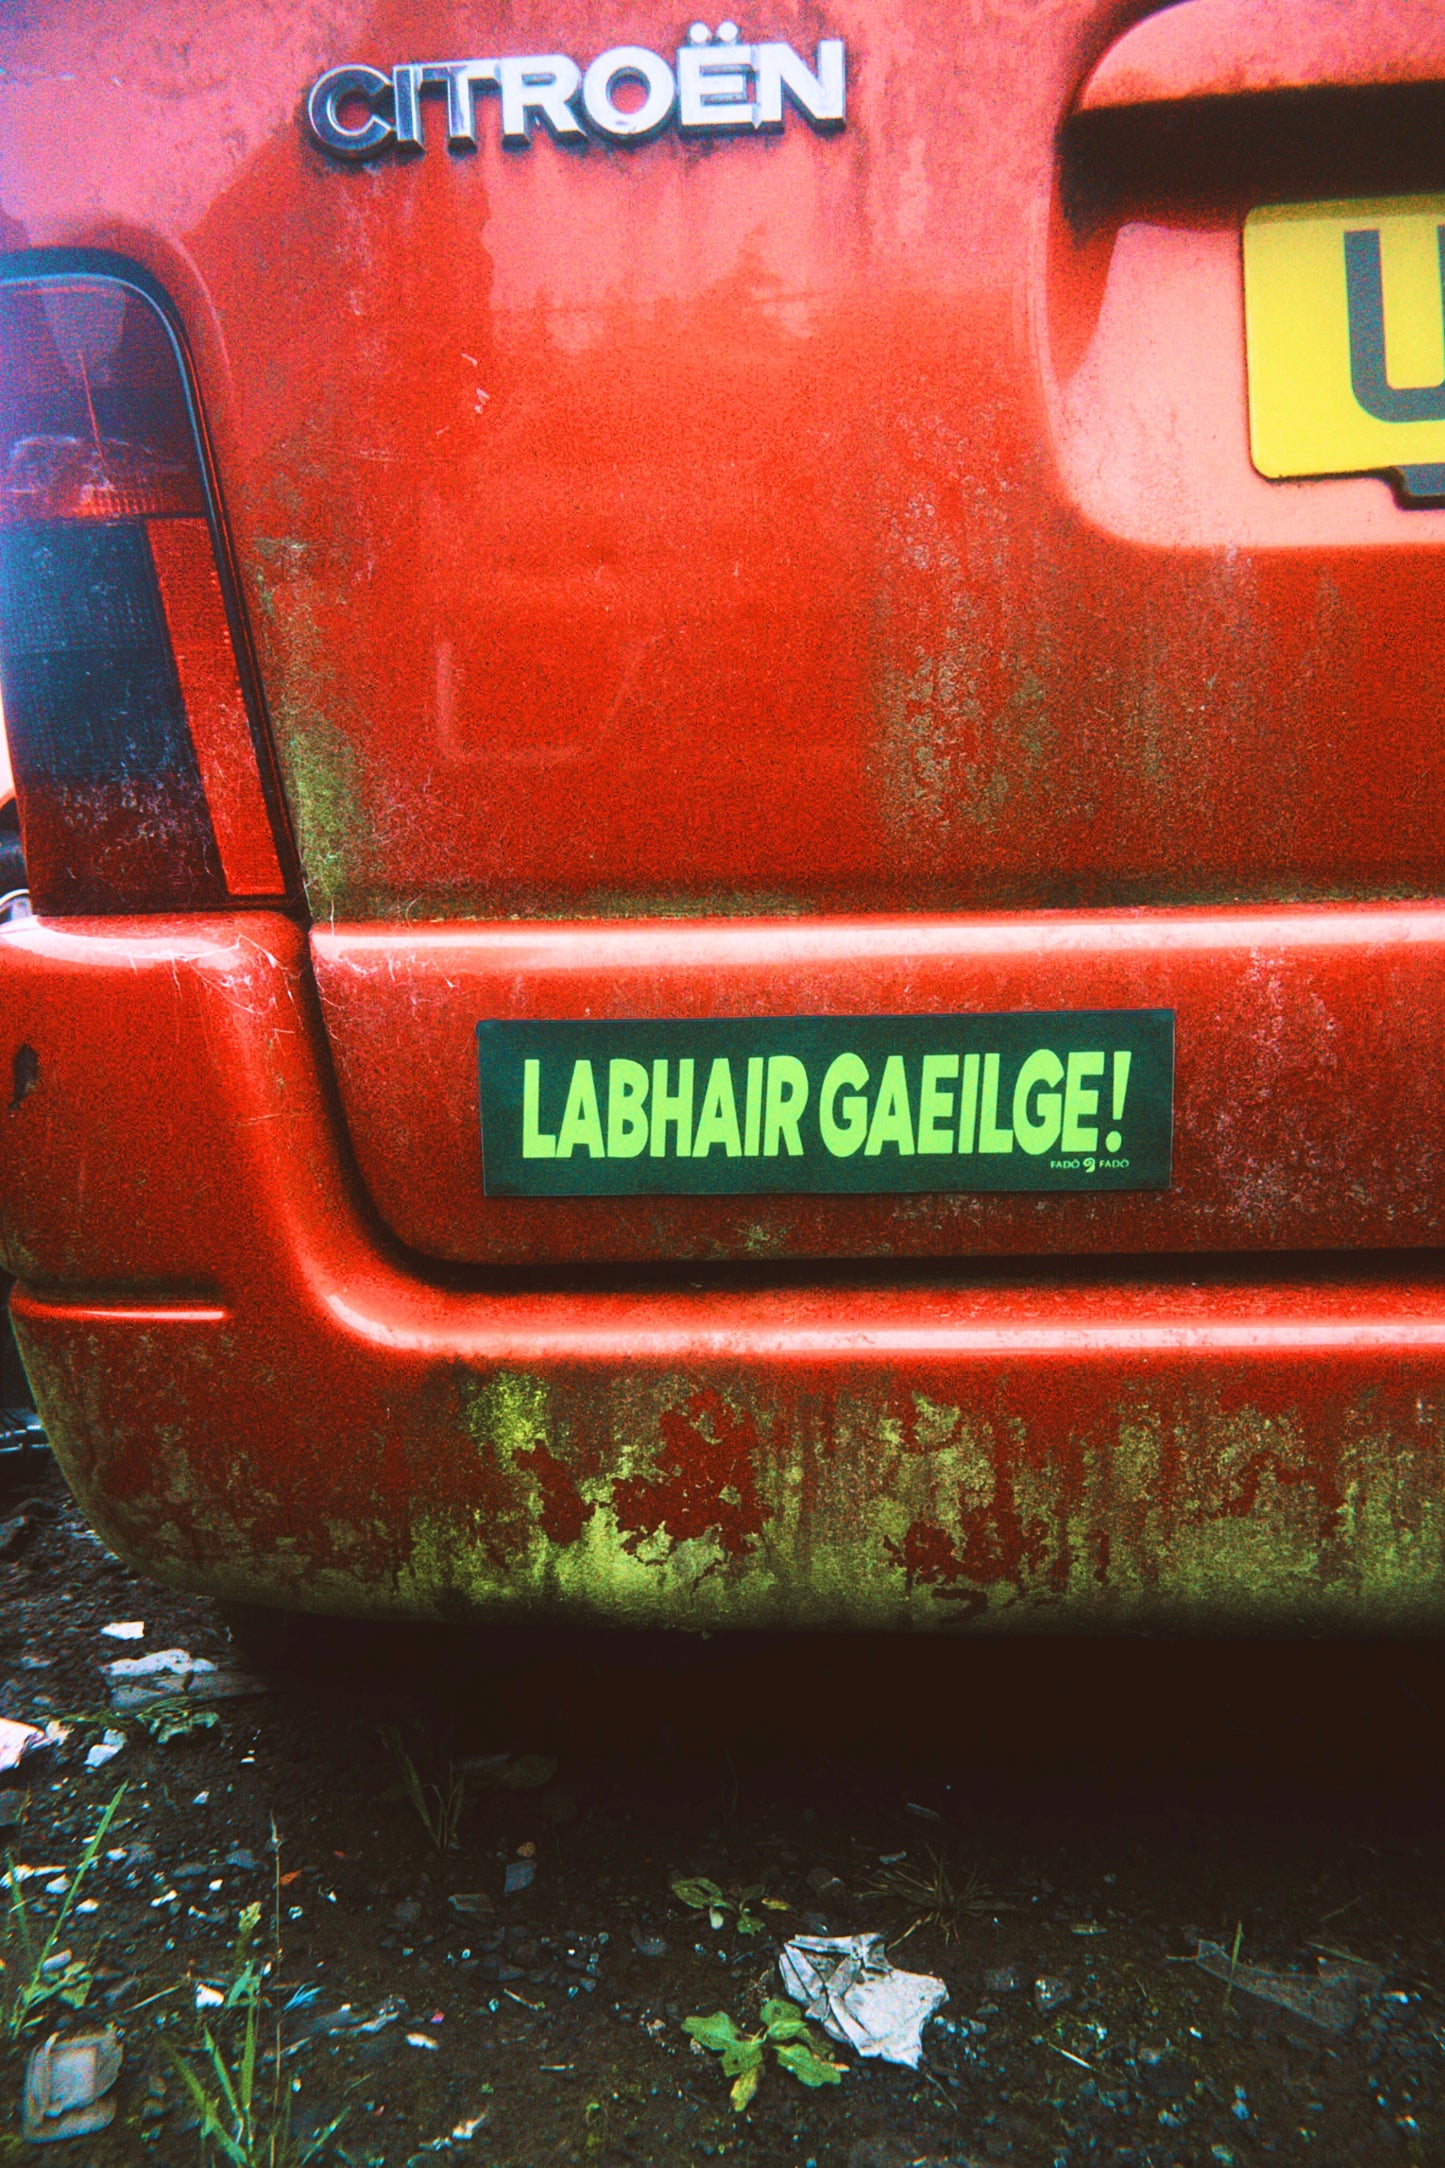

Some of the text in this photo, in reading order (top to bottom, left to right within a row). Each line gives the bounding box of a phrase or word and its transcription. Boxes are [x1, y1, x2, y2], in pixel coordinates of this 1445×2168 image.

[309, 22, 846, 154] CITROËN
[522, 1049, 1132, 1159] LABHAIR GAEILGE!
